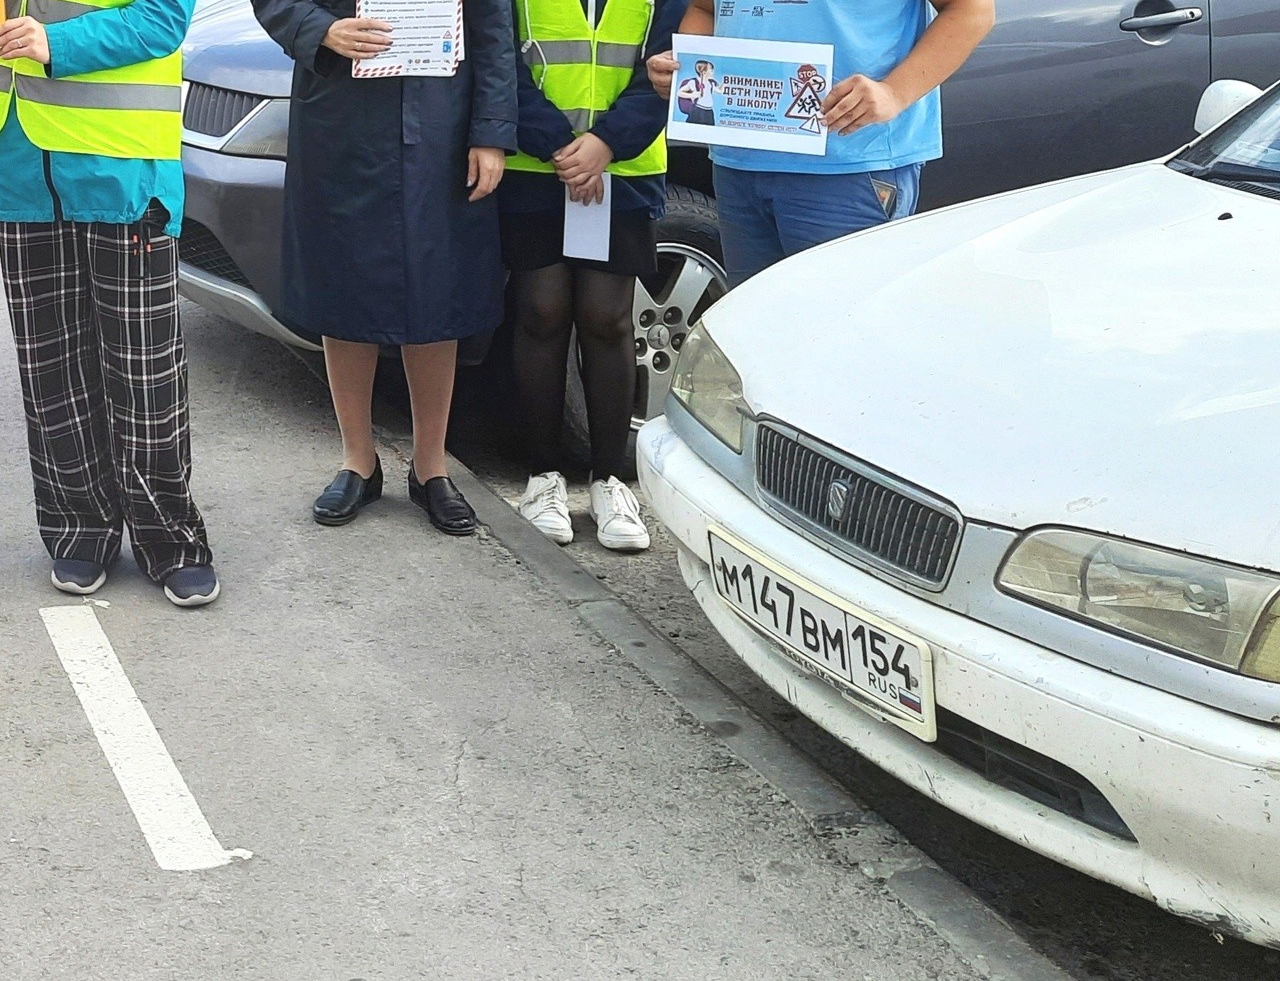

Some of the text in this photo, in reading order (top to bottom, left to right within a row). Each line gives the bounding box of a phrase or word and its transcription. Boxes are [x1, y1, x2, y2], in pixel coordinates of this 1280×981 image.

[798, 70, 817, 79] STOP
[723, 75, 784, 90] ВНИМАНИЕ!
[723, 85, 783, 101] ДЕТИ ИДУТ
[727, 98, 778, 110] В ШКОЛУ!
[851, 625, 912, 690] 154
[868, 671, 898, 700] RUS
